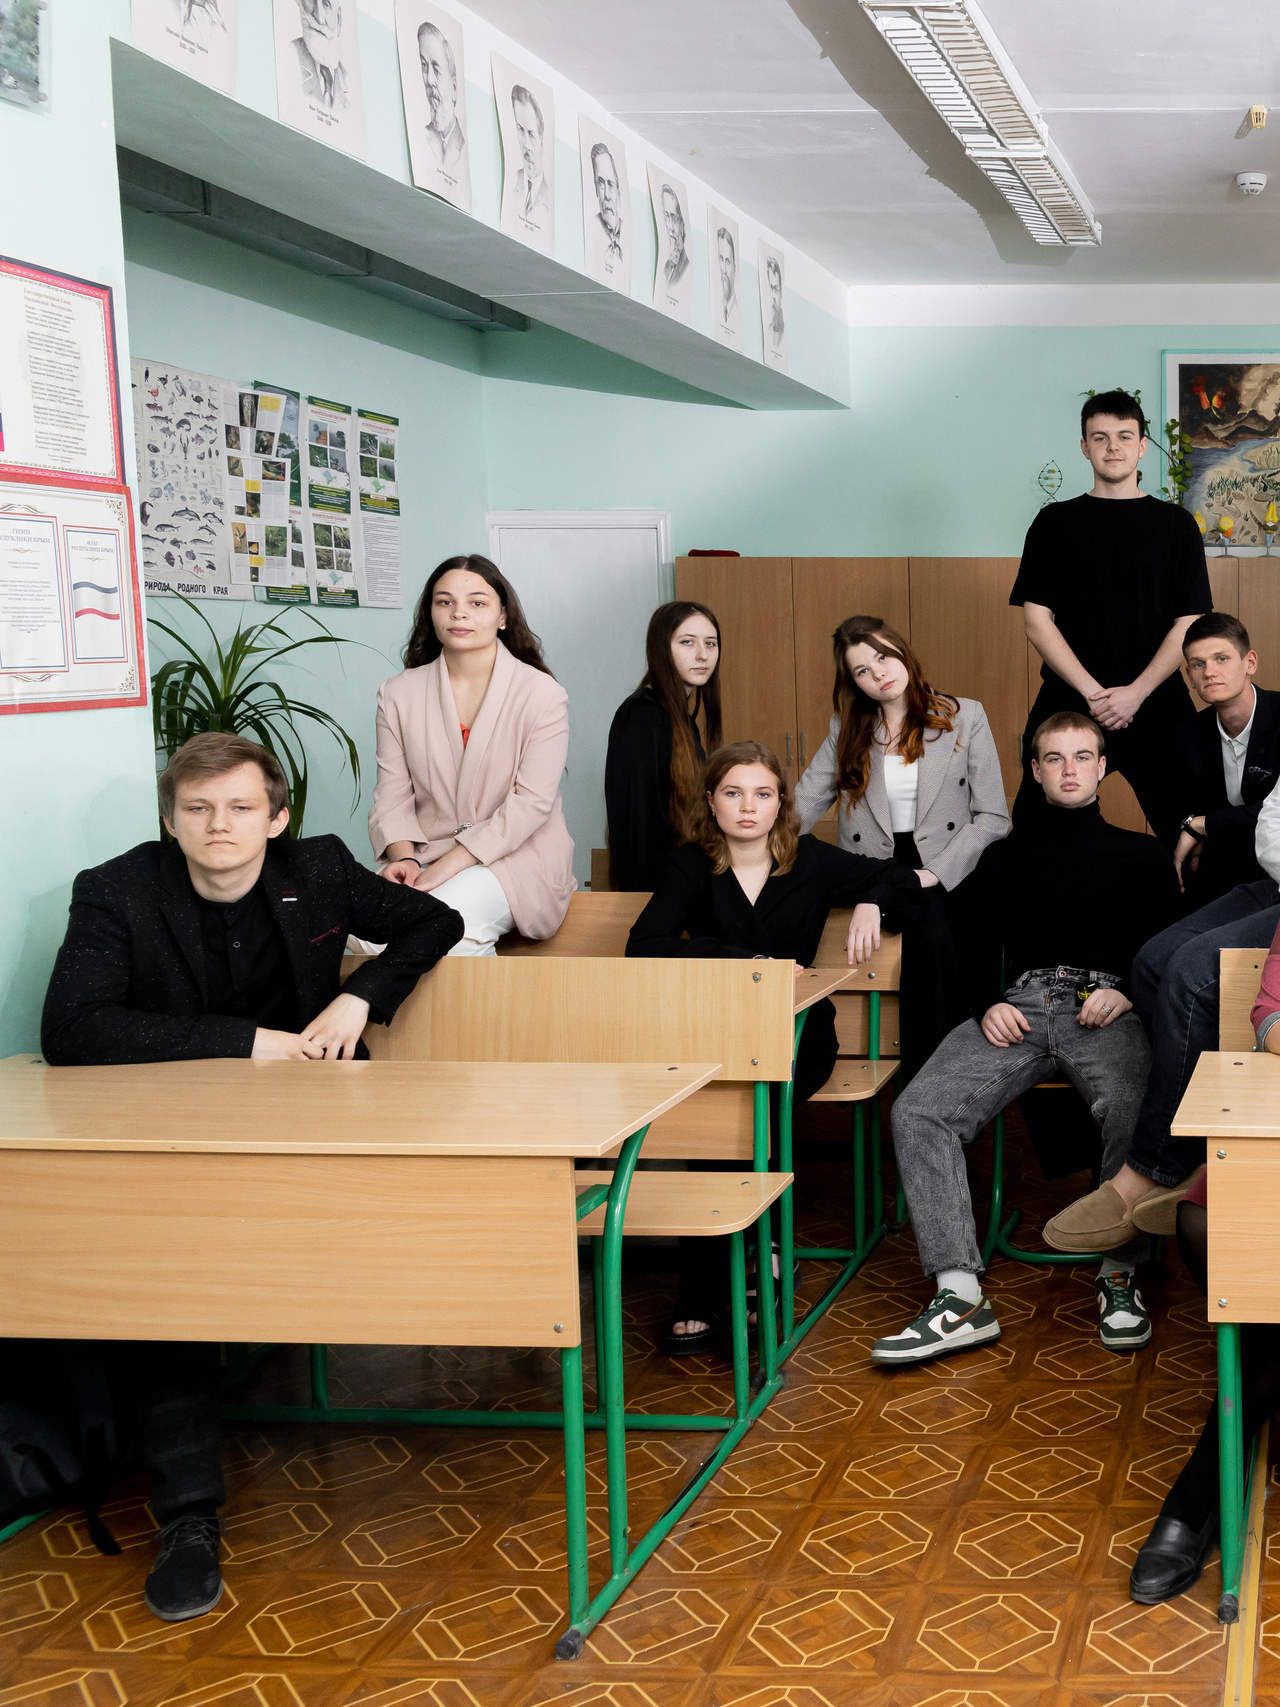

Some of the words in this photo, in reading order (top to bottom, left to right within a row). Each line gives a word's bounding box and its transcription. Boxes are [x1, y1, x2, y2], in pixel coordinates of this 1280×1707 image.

[0, 535, 33, 543] СПУБЛИКИ
[144, 581, 171, 593] РИРОДА
[177, 582, 207, 594] РОДНОГО
[213, 586, 229, 595] КРАЯ
